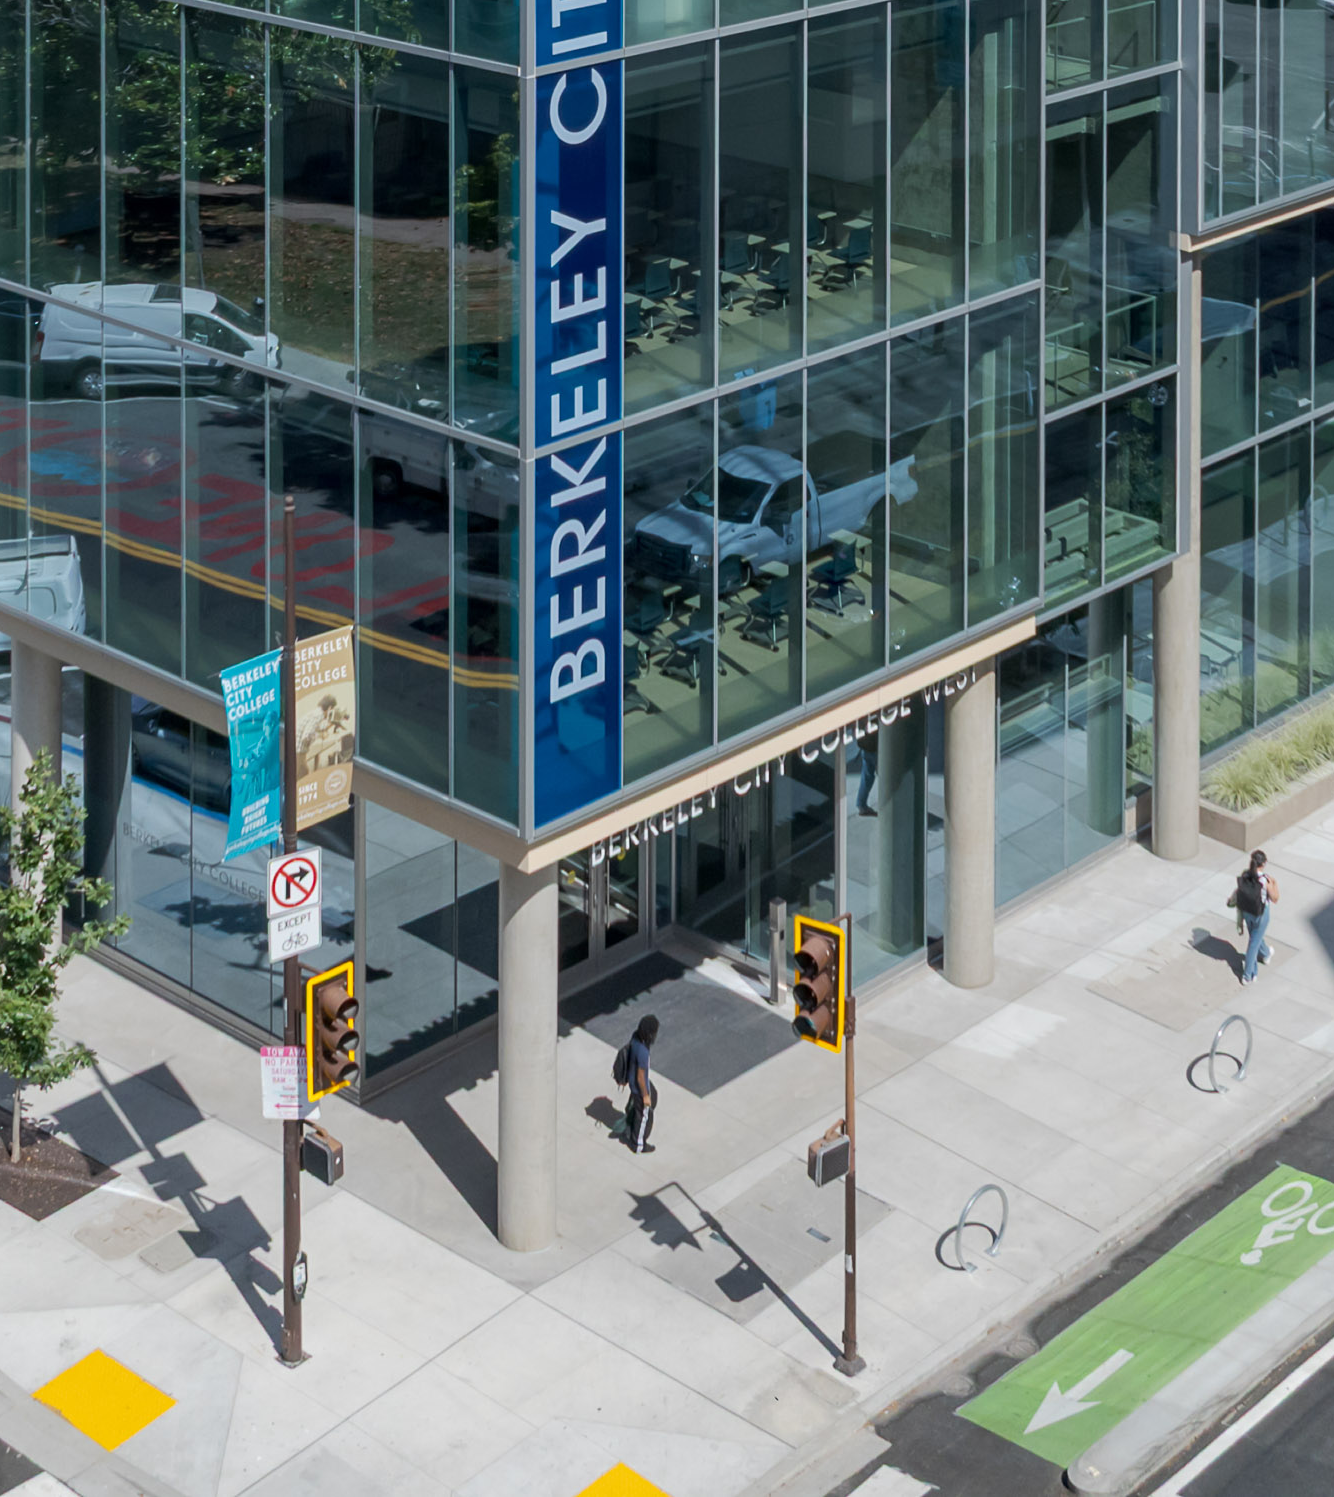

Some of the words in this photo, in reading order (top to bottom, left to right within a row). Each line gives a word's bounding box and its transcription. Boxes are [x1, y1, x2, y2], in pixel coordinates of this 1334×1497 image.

[549, 208, 608, 704] BERKELEY
[295, 635, 350, 663] BERKELEY
[222, 658, 280, 693] BERKELEY
[295, 659, 322, 678] CITY
[295, 665, 348, 691] COLLEGE
[226, 685, 253, 707] CITY
[227, 688, 276, 721] COLLEGE
[591, 789, 718, 868] BERKELEY
[733, 752, 786, 796] CITY
[801, 695, 912, 764] COLLEGE
[921, 663, 978, 706] WEST
[299, 781, 318, 795] SINCE
[299, 791, 318, 806] 1974
[277, 911, 312, 933] EXCEPT
[265, 1058, 276, 1066] NO
[288, 1047, 307, 1057] AWA
